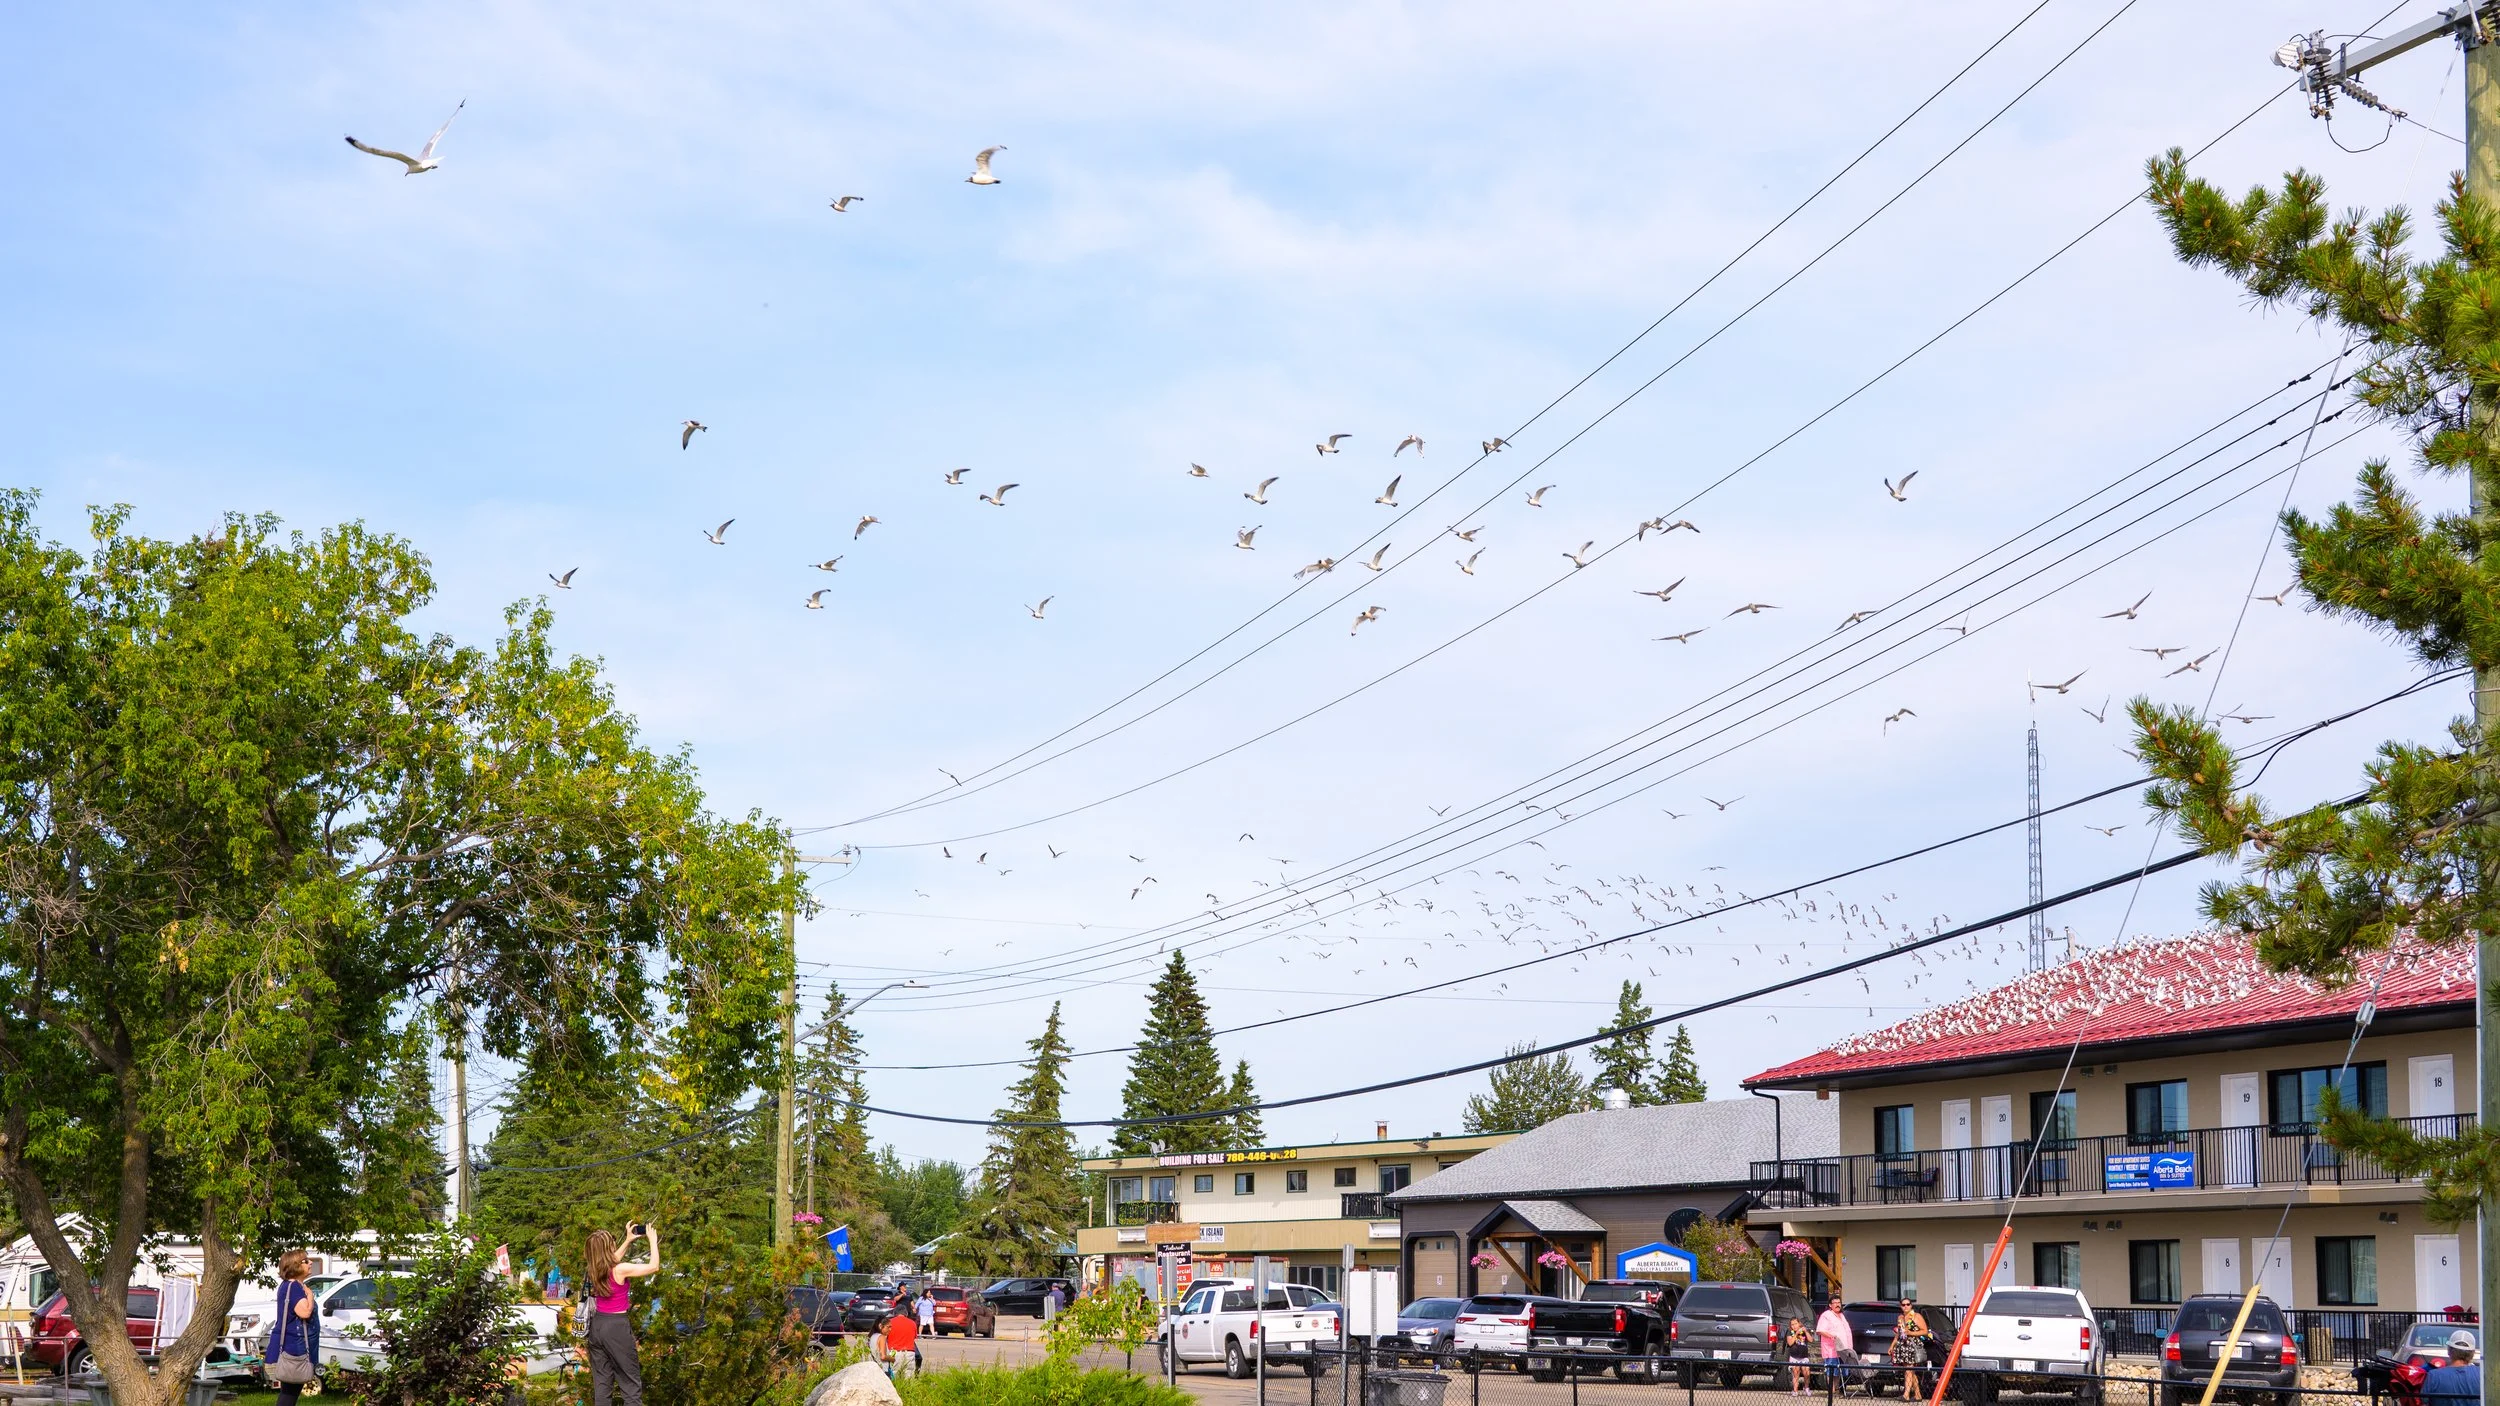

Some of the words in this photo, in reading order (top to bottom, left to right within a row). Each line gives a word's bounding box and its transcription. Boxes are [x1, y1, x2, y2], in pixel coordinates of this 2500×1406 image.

[2434, 1076, 2443, 1087] 18
[2243, 1092, 2251, 1102] 19
[1959, 1116, 1966, 1126] 21
[1998, 1113, 2007, 1122] 20
[1160, 1155, 1192, 1166] BUILDING
[1193, 1154, 1207, 1164] FOR
[1208, 1153, 1224, 1163] SALE
[2153, 1165, 2174, 1174] Alberta
[2174, 1164, 2193, 1173] Beach
[1206, 1227, 1223, 1236] ISLAND
[1157, 1250, 1191, 1258] Restaurant
[2003, 1260, 2008, 1270] 9
[2225, 1257, 2230, 1268] 8
[2275, 1257, 2281, 1268] 7
[2441, 1255, 2448, 1266] 6
[1962, 1261, 1969, 1271] 10
